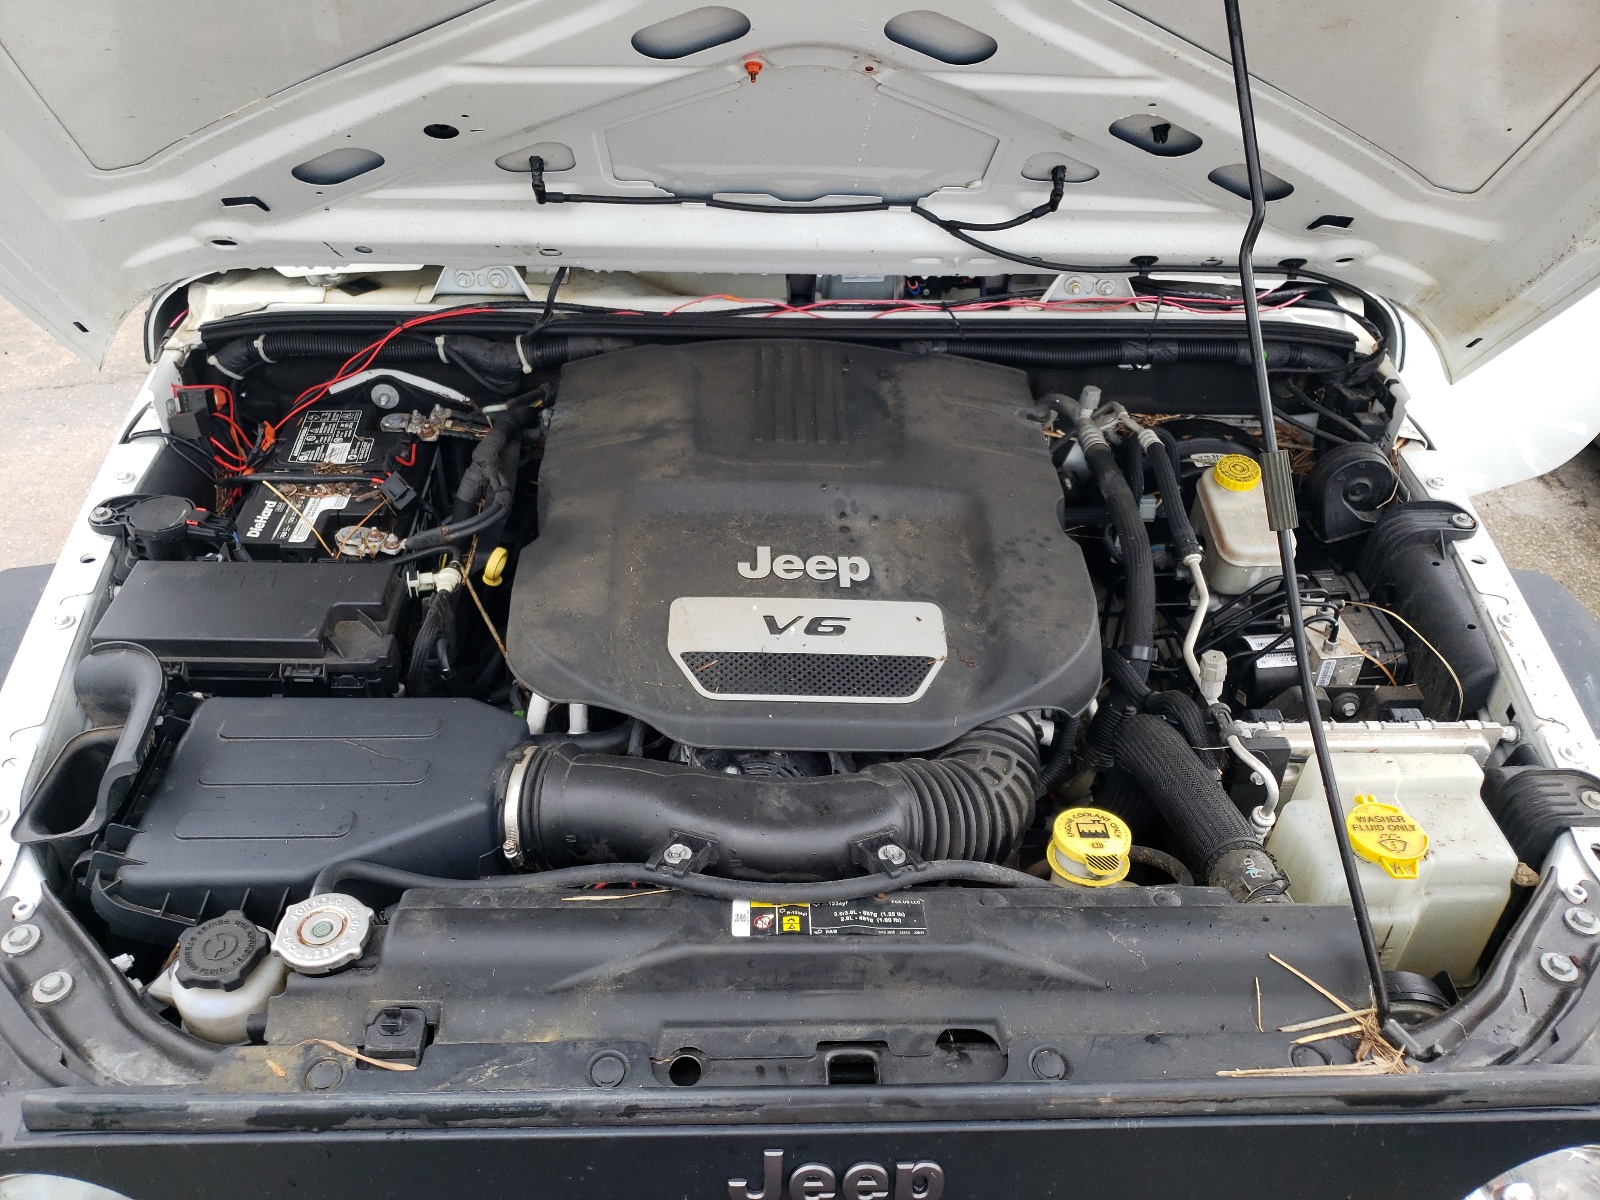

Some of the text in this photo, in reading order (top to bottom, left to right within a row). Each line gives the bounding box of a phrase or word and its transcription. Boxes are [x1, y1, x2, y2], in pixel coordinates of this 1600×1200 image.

[246, 500, 278, 538] DieHard
[737, 546, 871, 588] Jeep
[763, 615, 852, 637] V6
[1064, 812, 1123, 840] ENGINE COOLANT ONLY
[1352, 824, 1416, 832] FLUID ONLY
[1355, 815, 1406, 823] WASHER
[1243, 858, 1265, 879] RAD
[728, 1149, 945, 1200] Jeep
